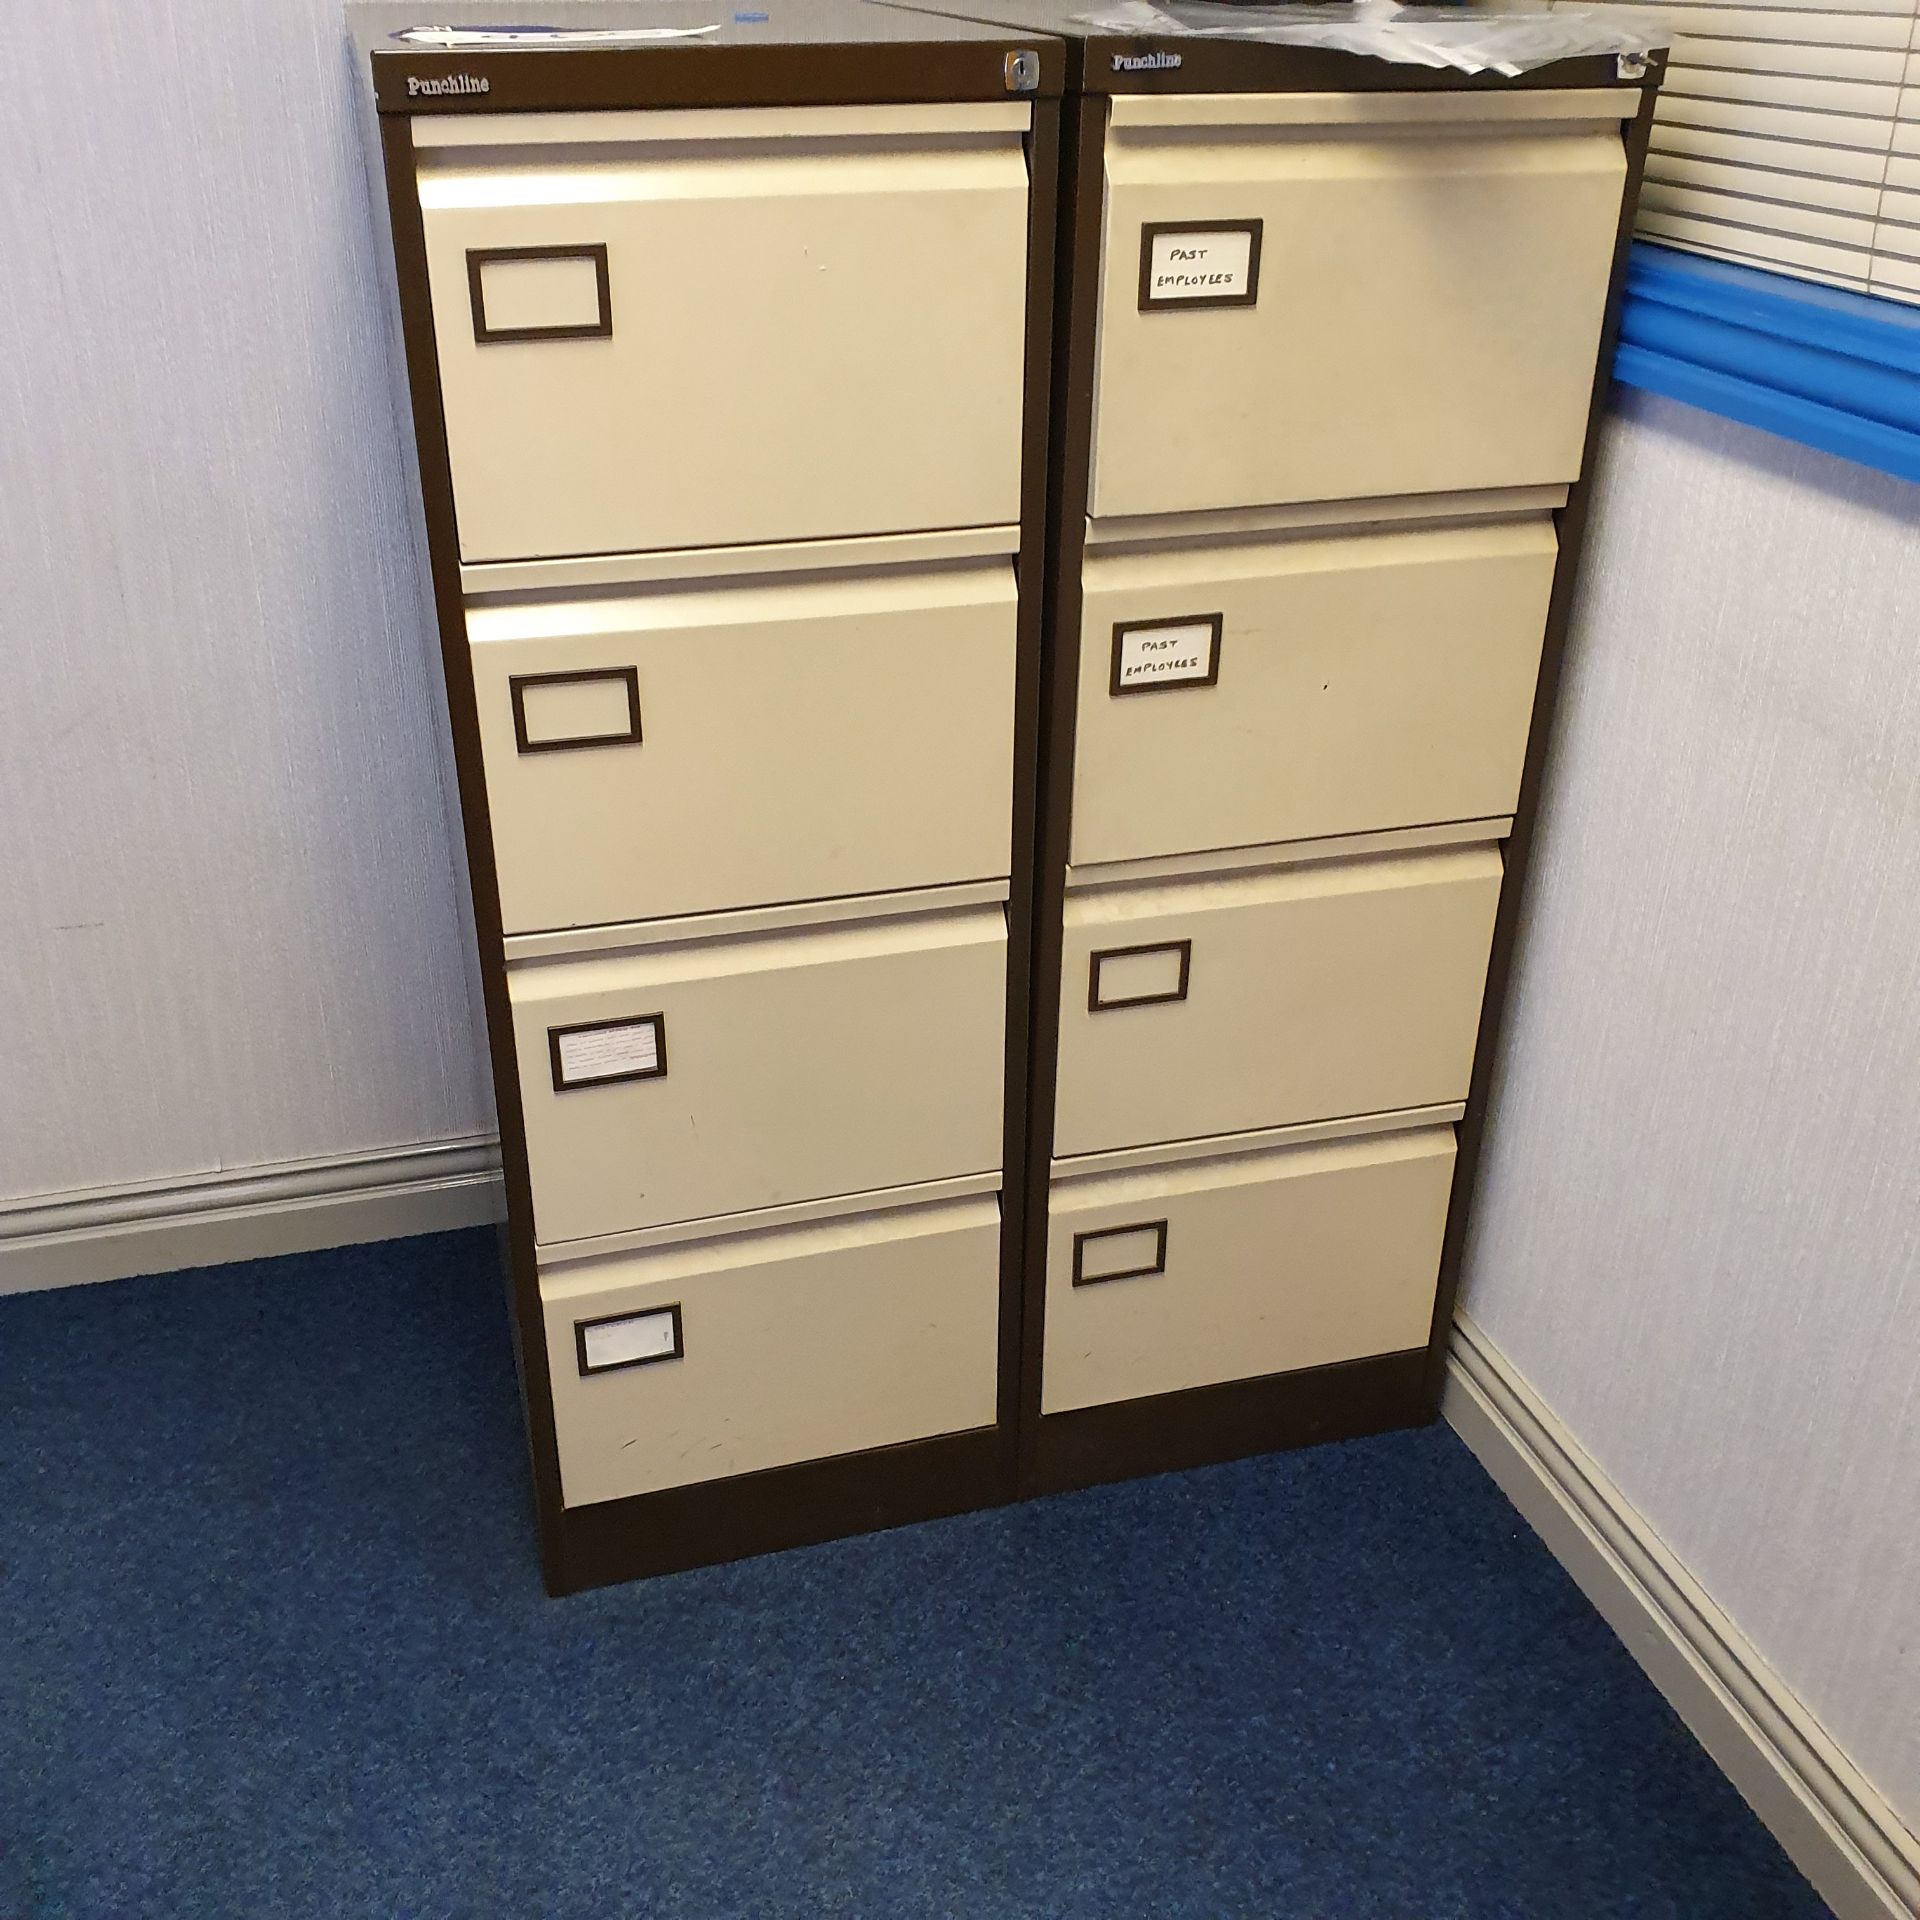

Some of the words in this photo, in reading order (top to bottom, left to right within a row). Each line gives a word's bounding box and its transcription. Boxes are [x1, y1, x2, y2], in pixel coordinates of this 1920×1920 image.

[1112, 52, 1182, 71] Punchline
[408, 74, 490, 95] Punchline
[1170, 249, 1208, 261] PAST
[1157, 273, 1234, 287] EMPLOYEES
[1142, 640, 1178, 652] PAST
[1126, 657, 1198, 677] EMPLOYEES
